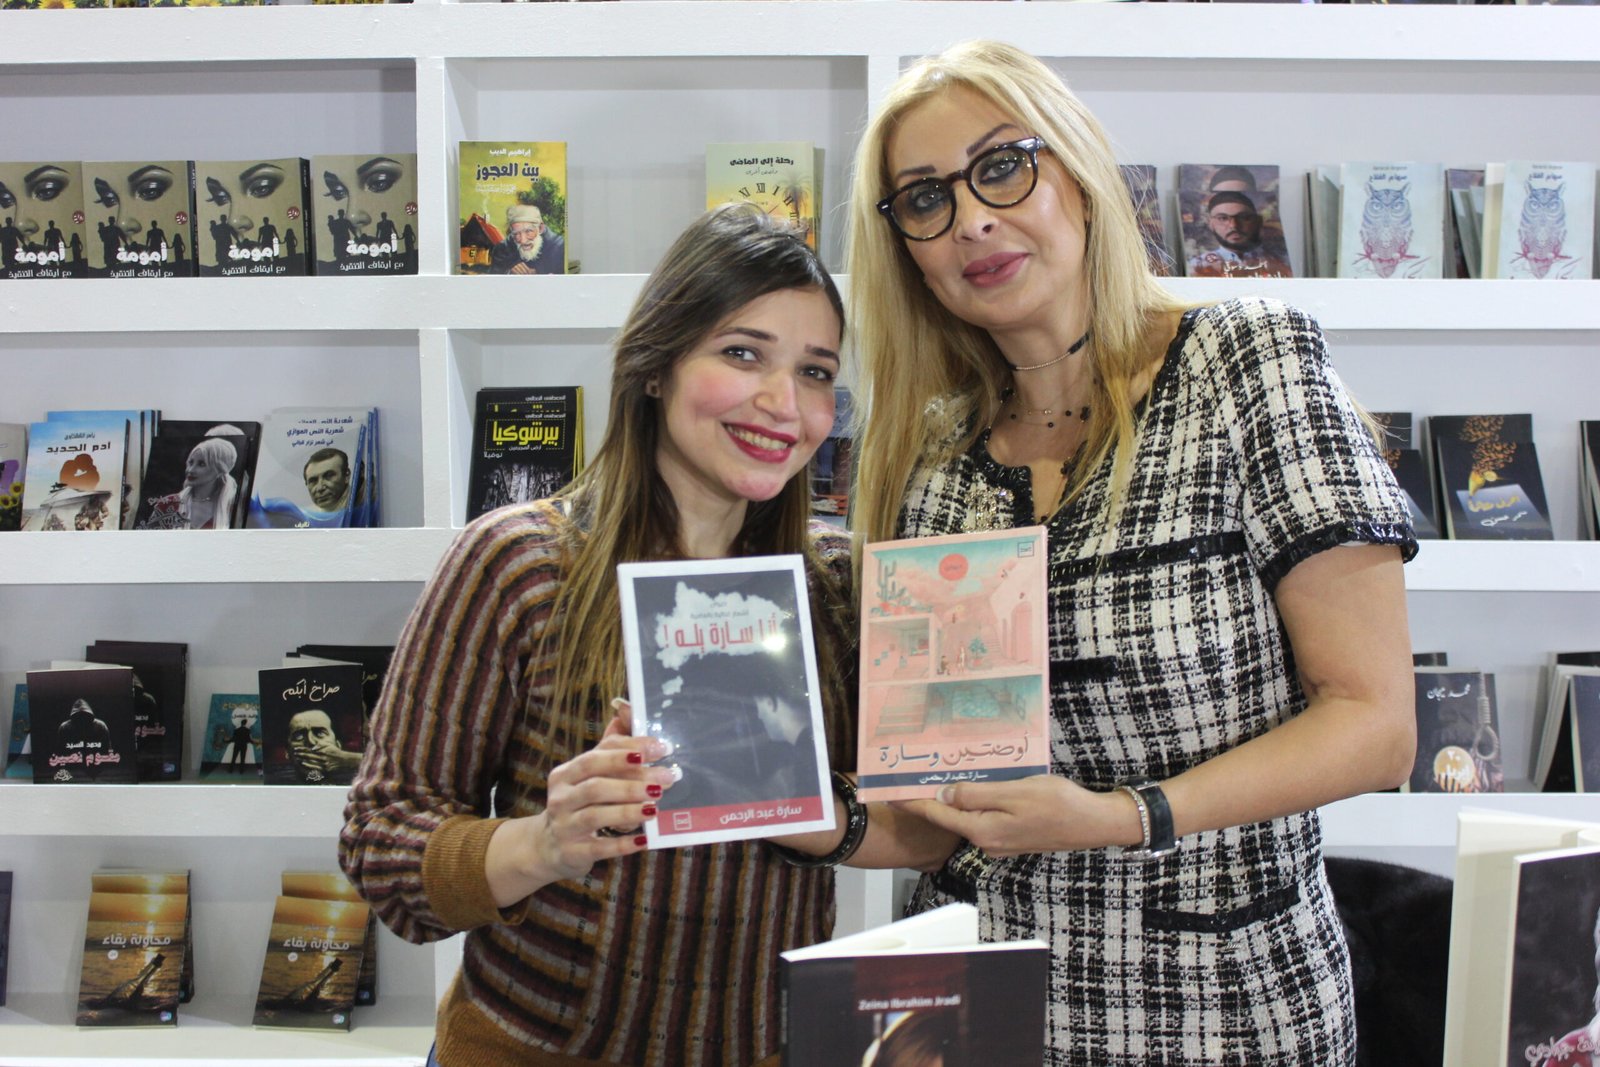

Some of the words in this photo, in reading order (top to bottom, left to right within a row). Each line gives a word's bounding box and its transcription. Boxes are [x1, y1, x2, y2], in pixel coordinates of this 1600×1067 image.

[760, 157, 773, 167] إلى
[775, 156, 794, 165] رحلة
[476, 162, 518, 181] العجوز
[522, 163, 539, 181] بيت
[14, 241, 65, 265] أمومة
[116, 241, 167, 265] أمومة
[228, 237, 280, 262] أمومة
[346, 233, 398, 257] أمومة
[394, 262, 404, 270] مع
[46, 443, 87, 454] الجديد
[710, 621, 753, 650] سارة
[361, 671, 378, 685] صرا
[282, 678, 307, 701] أبكم
[309, 680, 340, 702] صراخ
[66, 740, 84, 749] السيد
[942, 731, 1029, 765] أوضتين
[880, 744, 940, 768] وسارة
[968, 771, 989, 781] سارة
[719, 808, 755, 825] الرحمن
[756, 808, 775, 820] عبد
[777, 805, 803, 819] سارة
[102, 933, 127, 948] بقاء
[130, 933, 171, 948] محاولة
[283, 936, 307, 952] بقاء
[310, 937, 350, 952] محاولة
